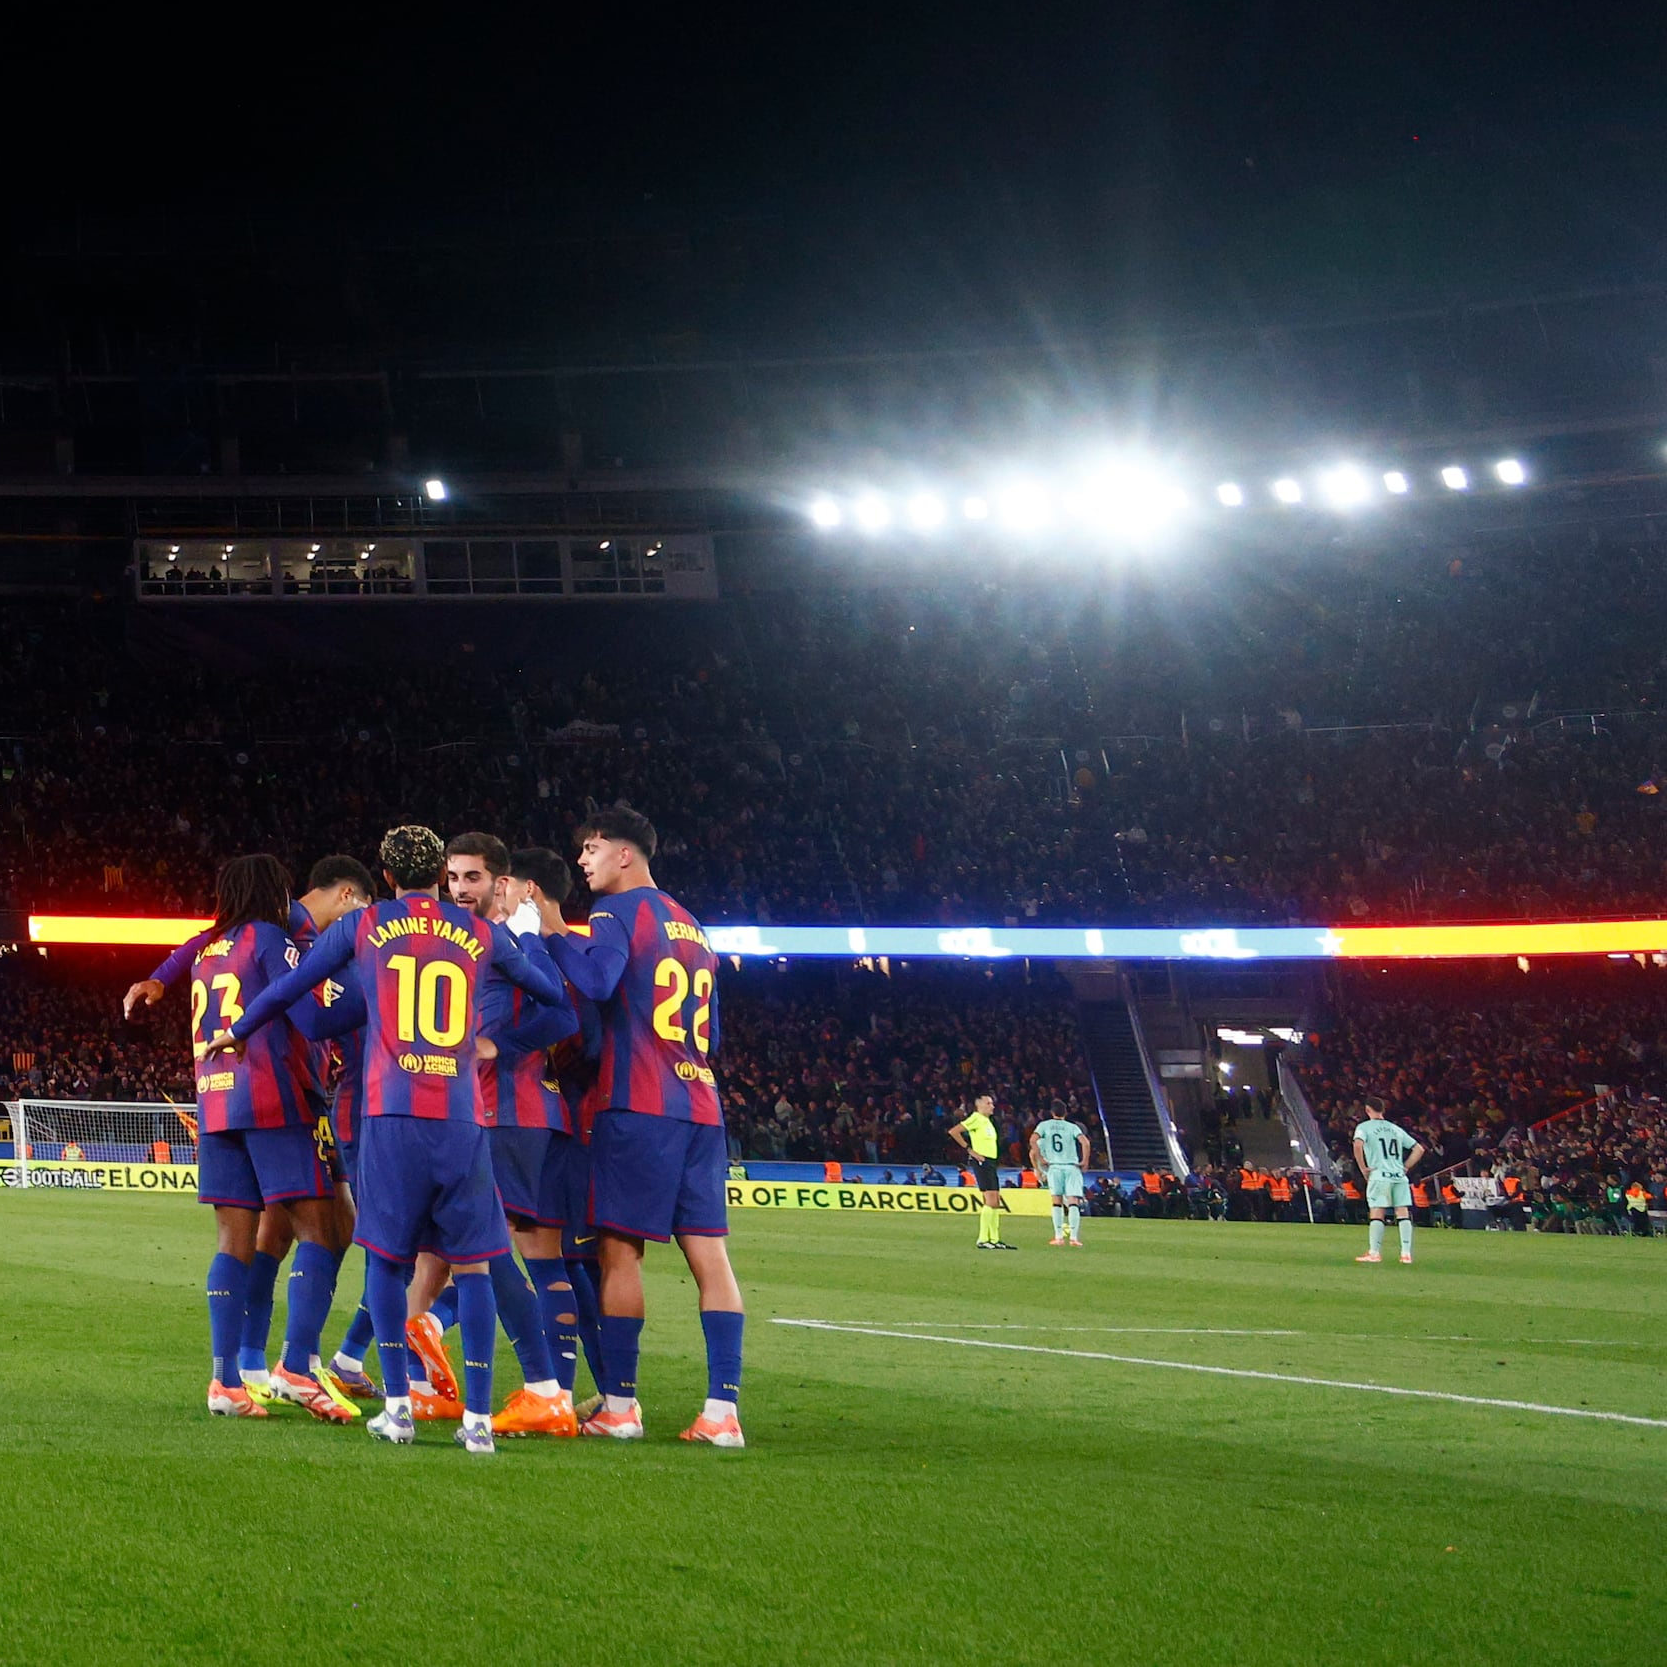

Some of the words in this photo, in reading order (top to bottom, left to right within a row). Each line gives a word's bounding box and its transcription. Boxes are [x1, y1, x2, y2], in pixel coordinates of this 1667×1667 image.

[367, 917, 428, 948] LAMINE
[432, 919, 485, 961] YAMAL
[191, 972, 244, 1060] 23
[386, 954, 468, 1048] 10
[653, 957, 713, 1054] 22
[1052, 1133, 1063, 1153] 6
[1378, 1137, 1400, 1160] 14
[752, 1186, 787, 1207] OF
[798, 1188, 830, 1208] FC
